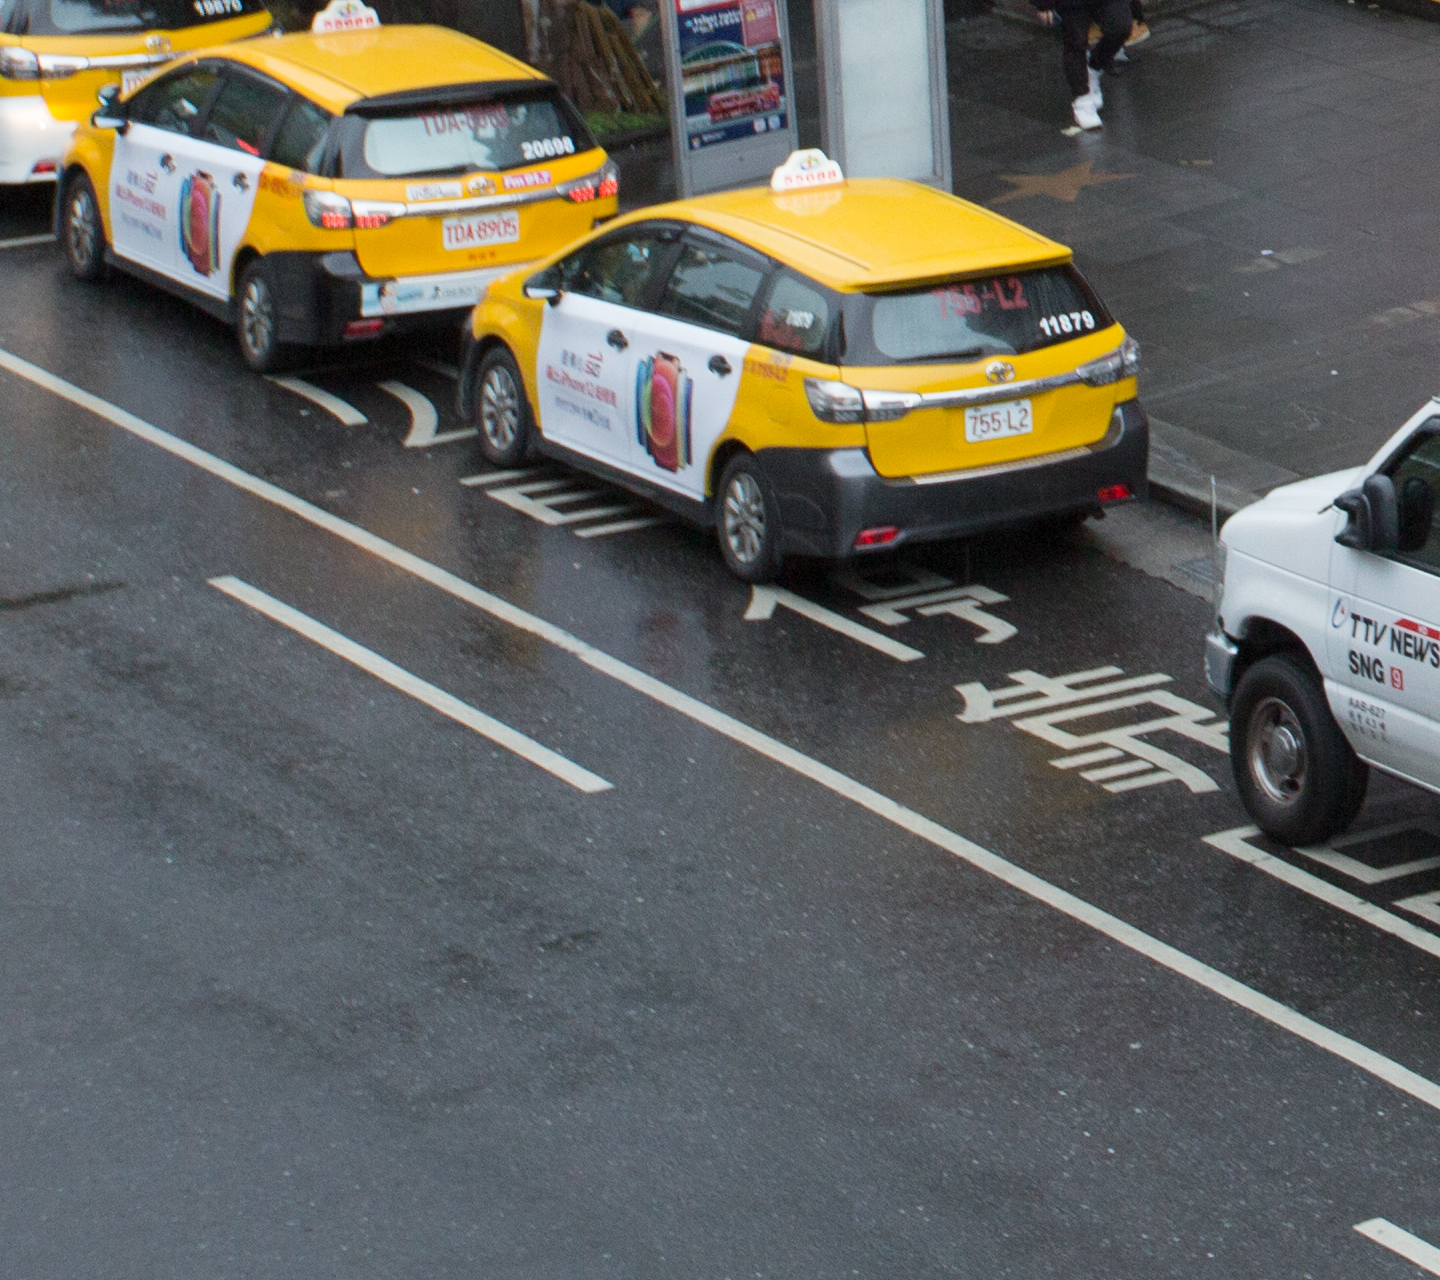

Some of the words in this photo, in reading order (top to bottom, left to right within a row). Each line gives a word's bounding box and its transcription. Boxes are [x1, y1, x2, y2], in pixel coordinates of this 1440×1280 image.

[1040, 310, 1095, 337] 11879
[1351, 612, 1387, 646] TTV
[1390, 627, 1440, 669] NEWS
[1348, 649, 1385, 684] SNG
